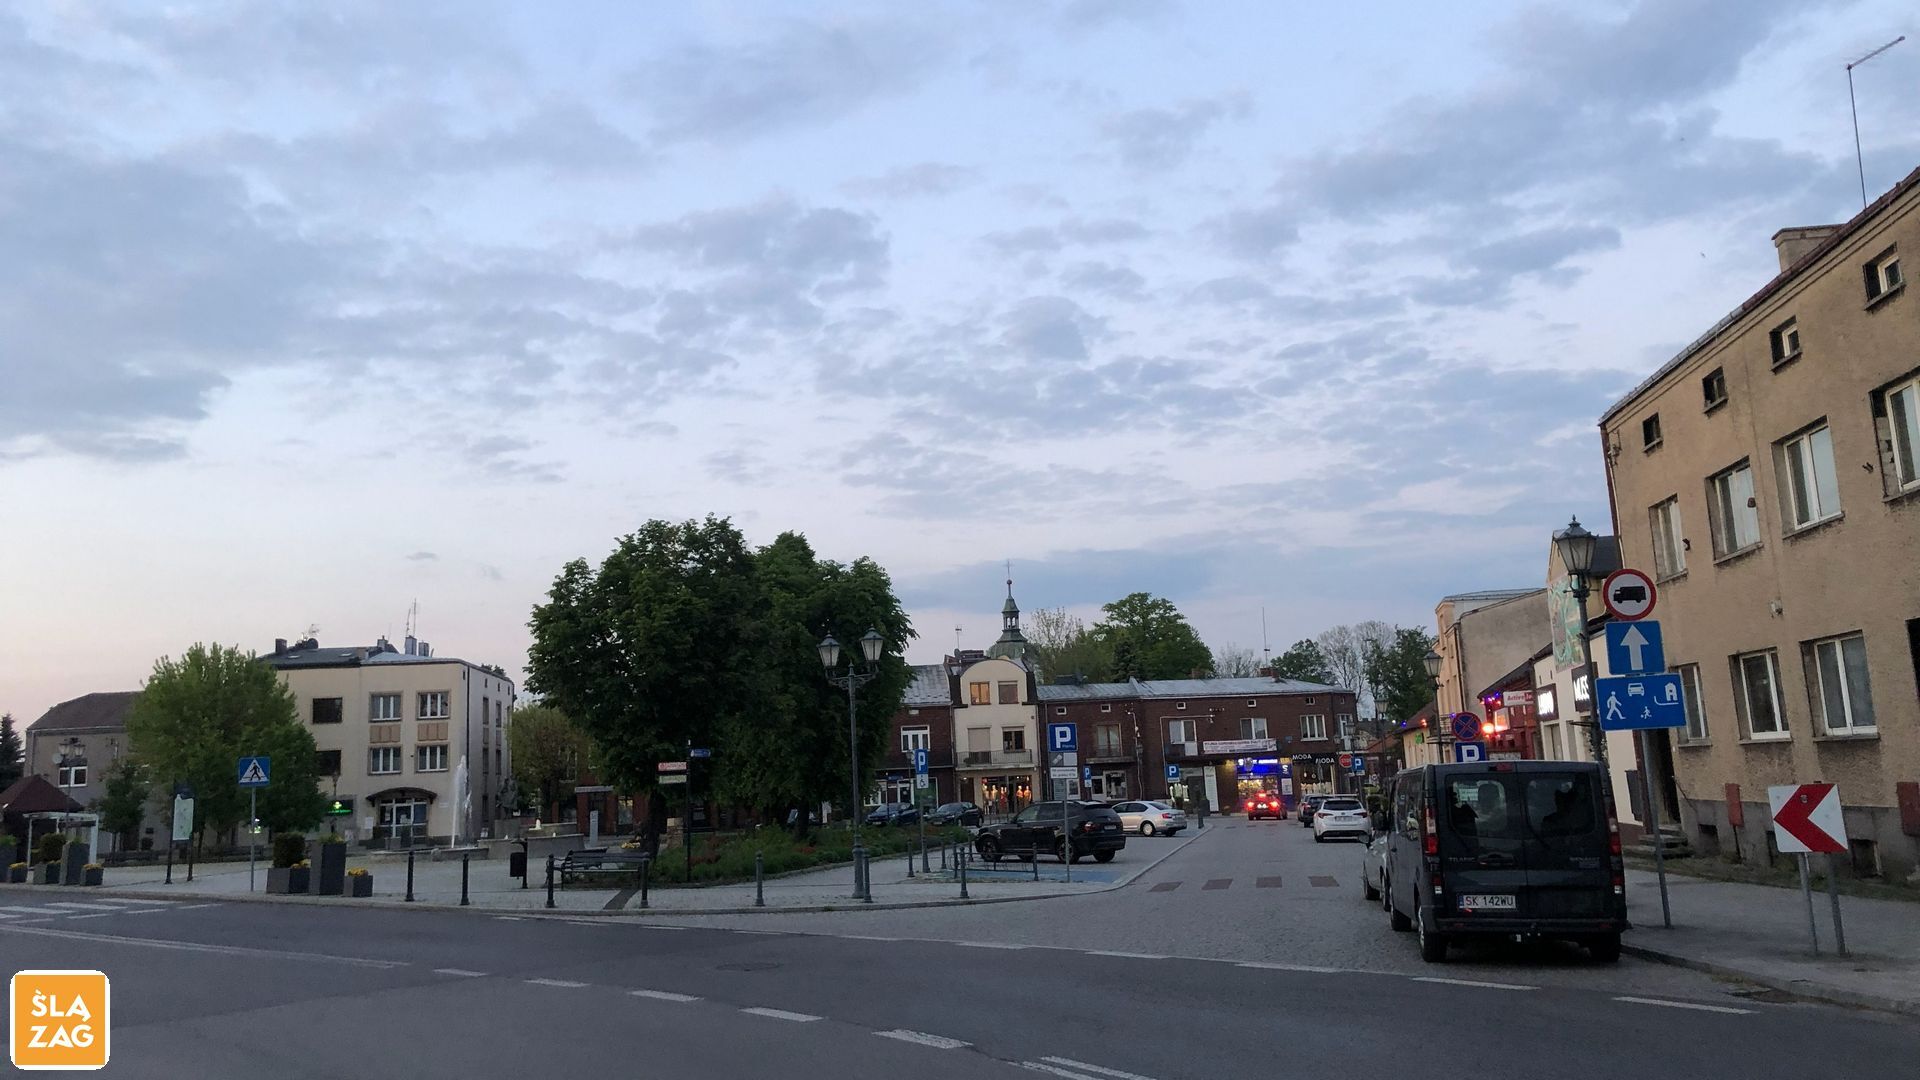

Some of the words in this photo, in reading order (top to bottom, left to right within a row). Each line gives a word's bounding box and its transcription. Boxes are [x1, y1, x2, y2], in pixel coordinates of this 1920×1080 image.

[1055, 726, 1072, 748] P
[918, 751, 926, 771] P
[1354, 758, 1362, 769] P
[1084, 767, 1090, 778] P
[1168, 765, 1177, 776] P
[1465, 895, 1479, 906] SK
[1483, 895, 1514, 906] 142WU
